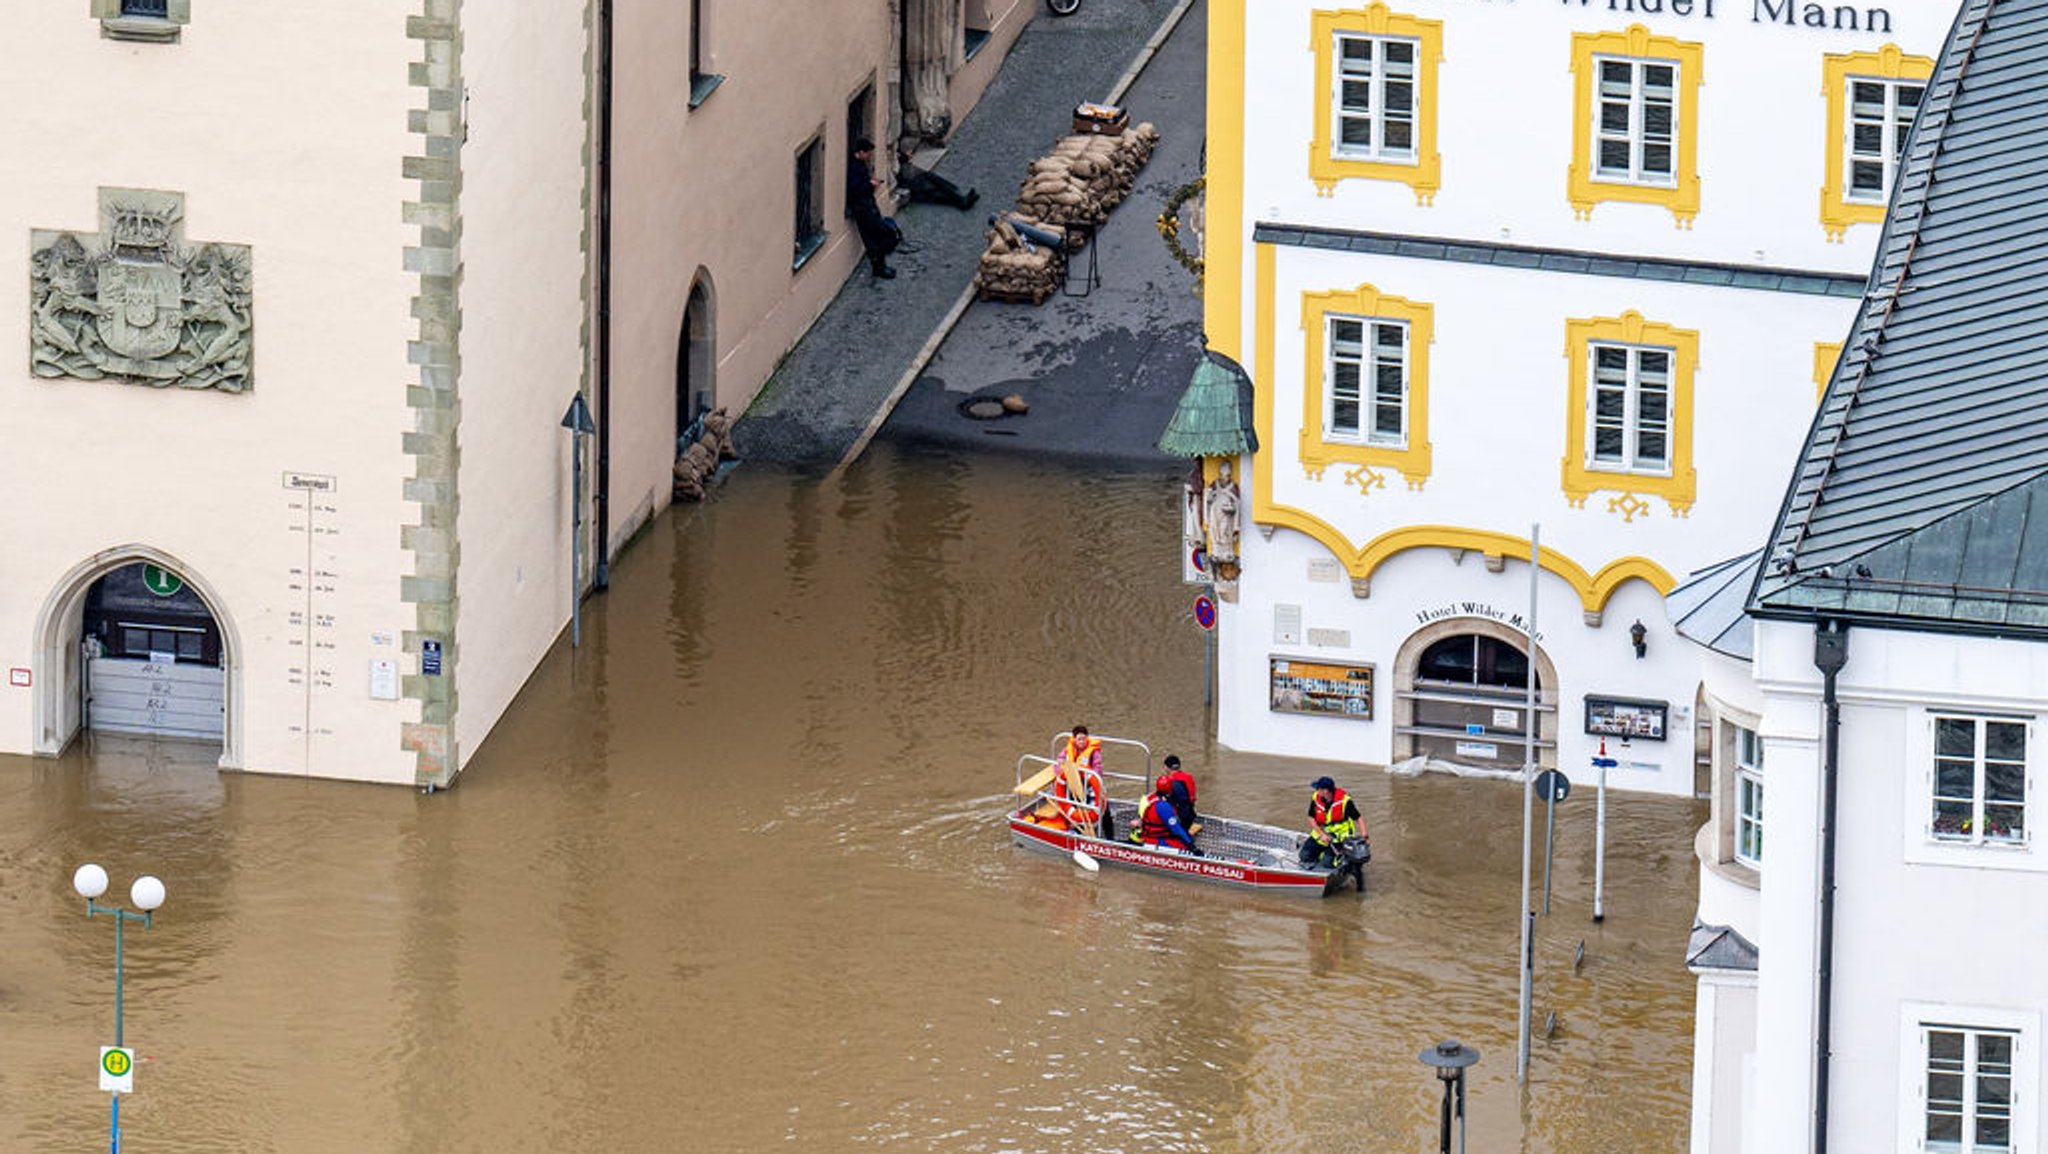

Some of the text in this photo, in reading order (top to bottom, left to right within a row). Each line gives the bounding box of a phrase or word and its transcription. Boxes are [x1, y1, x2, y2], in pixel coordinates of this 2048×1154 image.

[1751, 0, 1892, 33] Mann
[1416, 602, 1543, 641] Hotel Wilder Man
[1080, 842, 1245, 880] KATASTROPHENSCHUTZ PASSAU
